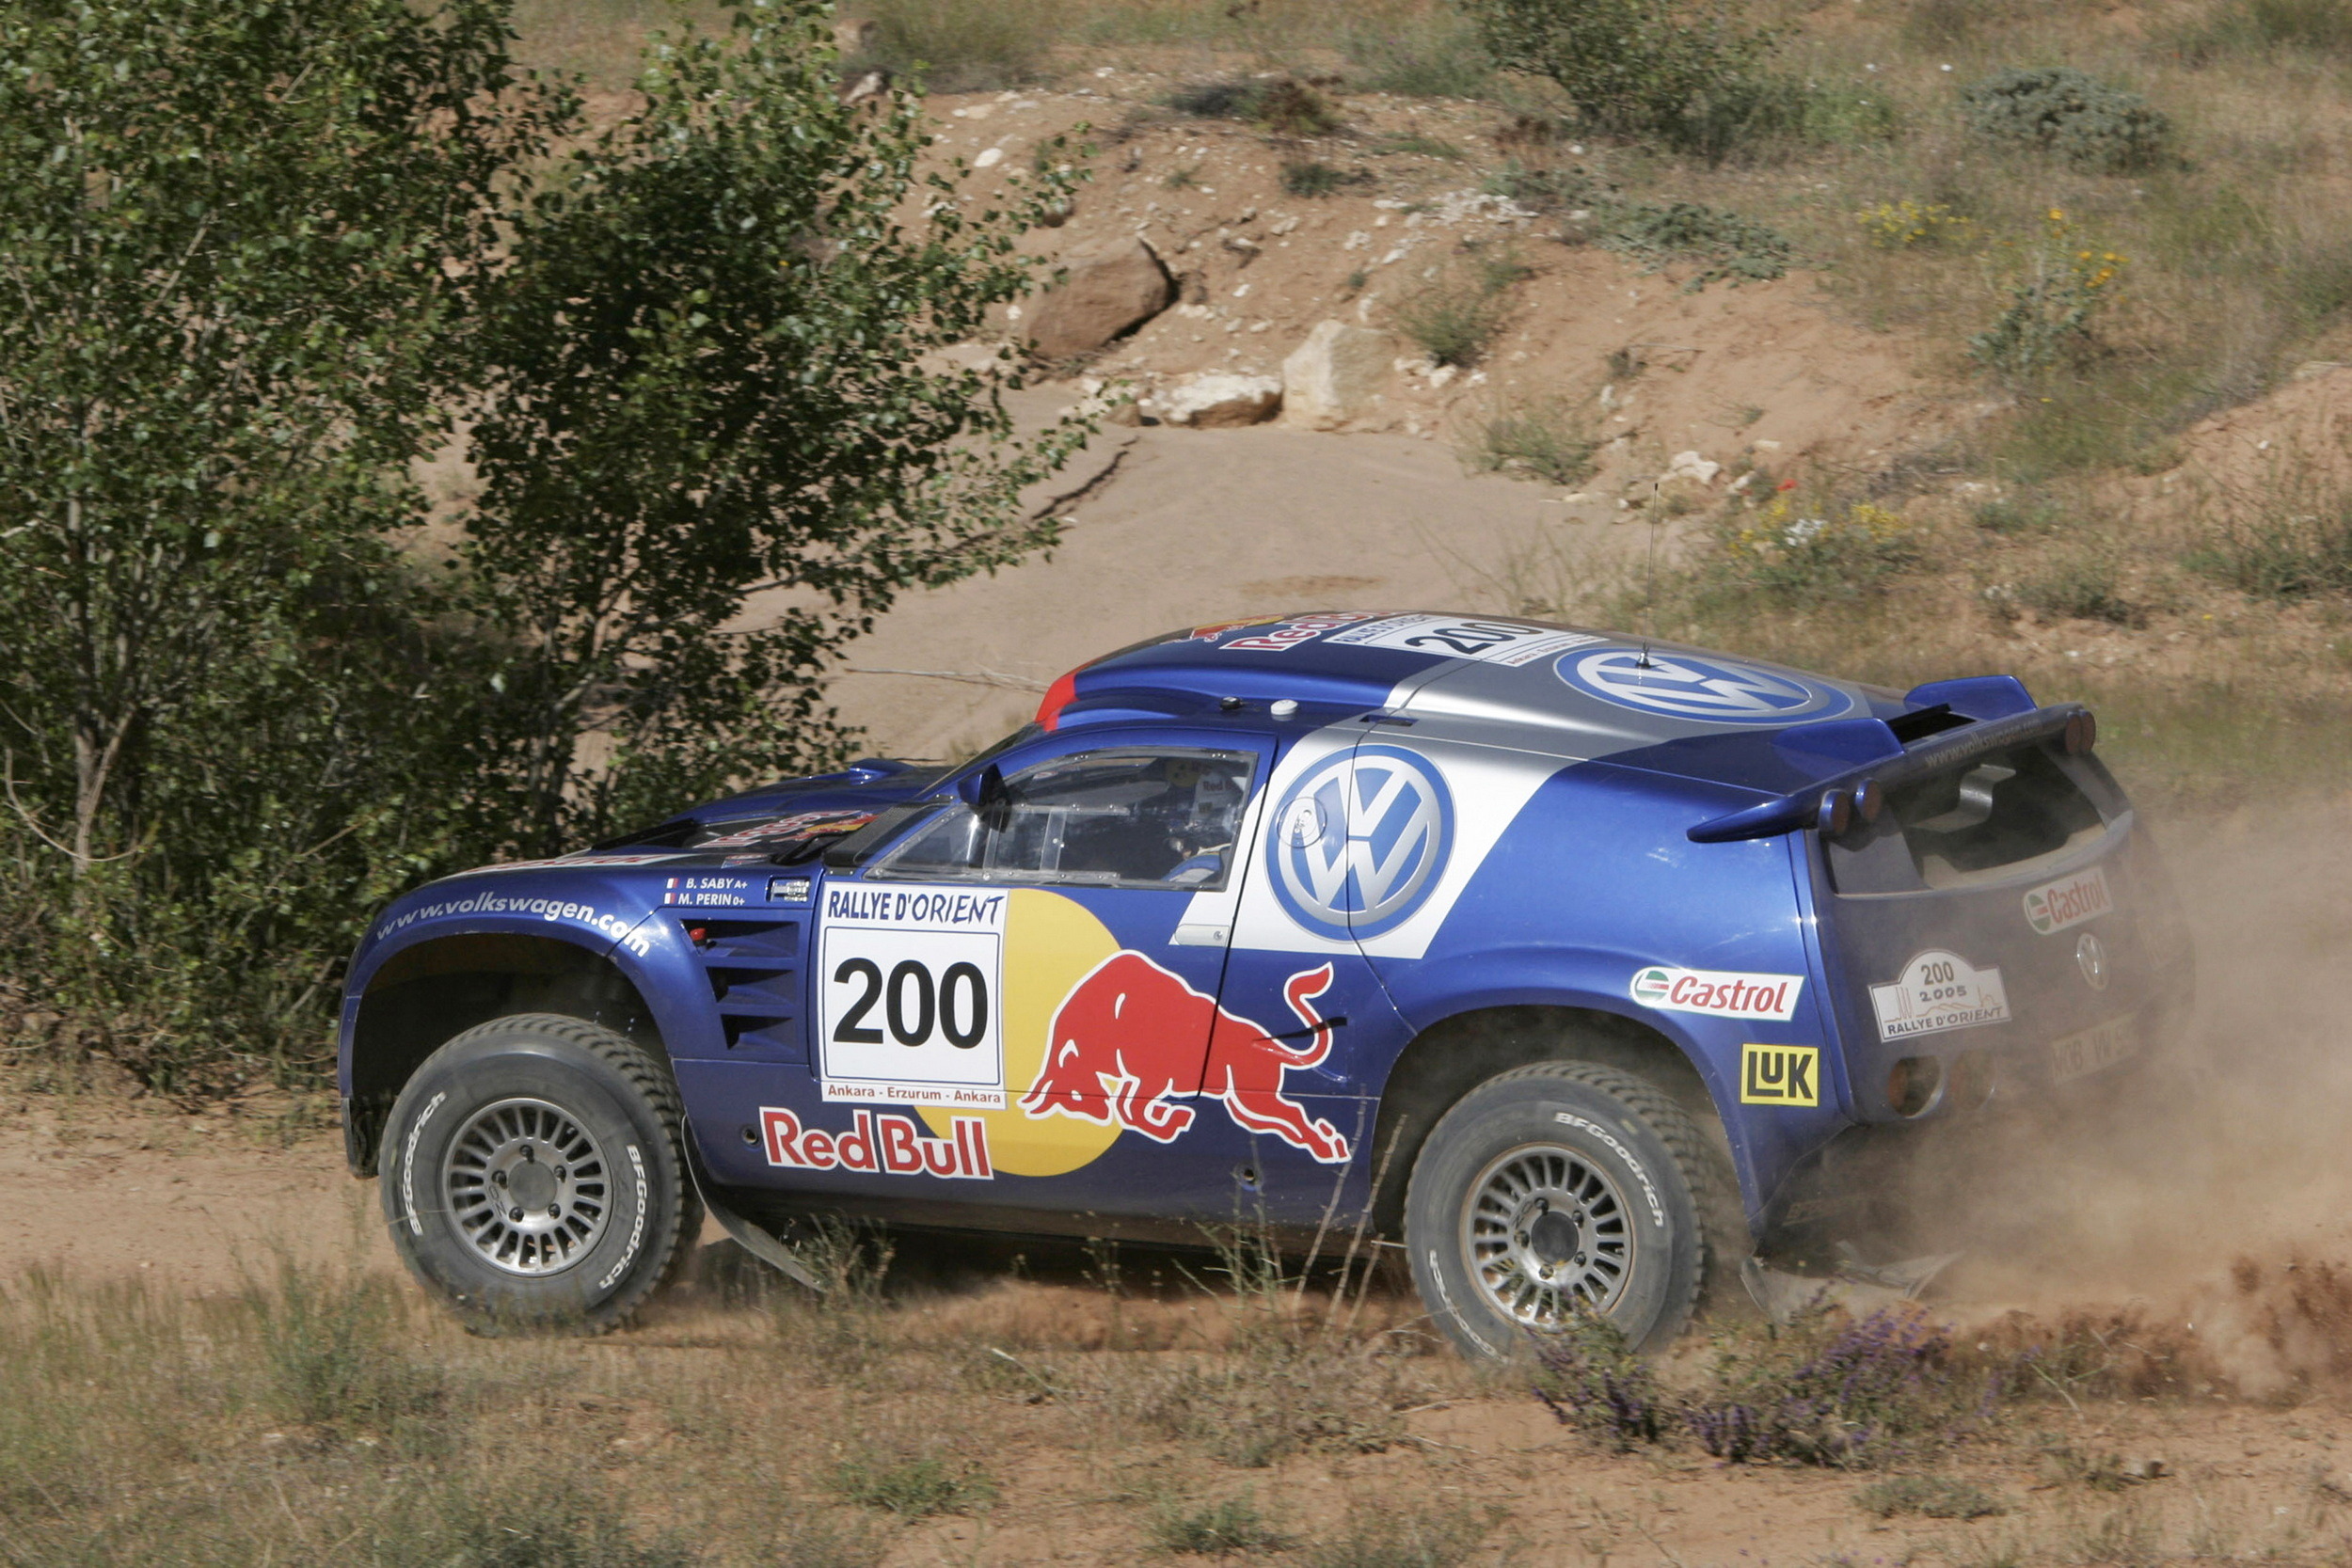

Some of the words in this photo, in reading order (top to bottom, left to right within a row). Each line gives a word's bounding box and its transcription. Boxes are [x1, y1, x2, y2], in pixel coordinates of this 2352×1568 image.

[1405, 622, 1544, 655] 200
[677, 893, 692, 905] M.
[696, 894, 732, 906] PERIN
[686, 878, 697, 889] B.
[700, 878, 734, 890] SABY
[2046, 872, 2108, 924] Castrol
[377, 891, 650, 958] www.volkswagen.com
[828, 890, 890, 921] RALLYE
[895, 892, 1006, 926] D'ORIENT
[1921, 961, 1955, 986] 200
[833, 957, 988, 1050] 200
[1670, 974, 1788, 1014] Castrol
[1887, 1017, 1933, 1035] RALLYE
[1936, 1006, 2003, 1027] D'ORIENT
[828, 1084, 875, 1098] Ankara
[887, 1086, 942, 1101] Erzurum
[954, 1089, 1001, 1103] Ankara
[403, 1091, 447, 1236] BFGoodrich
[1554, 1111, 1664, 1228] BFGoodrich
[599, 1145, 648, 1290] BFGoodrich
